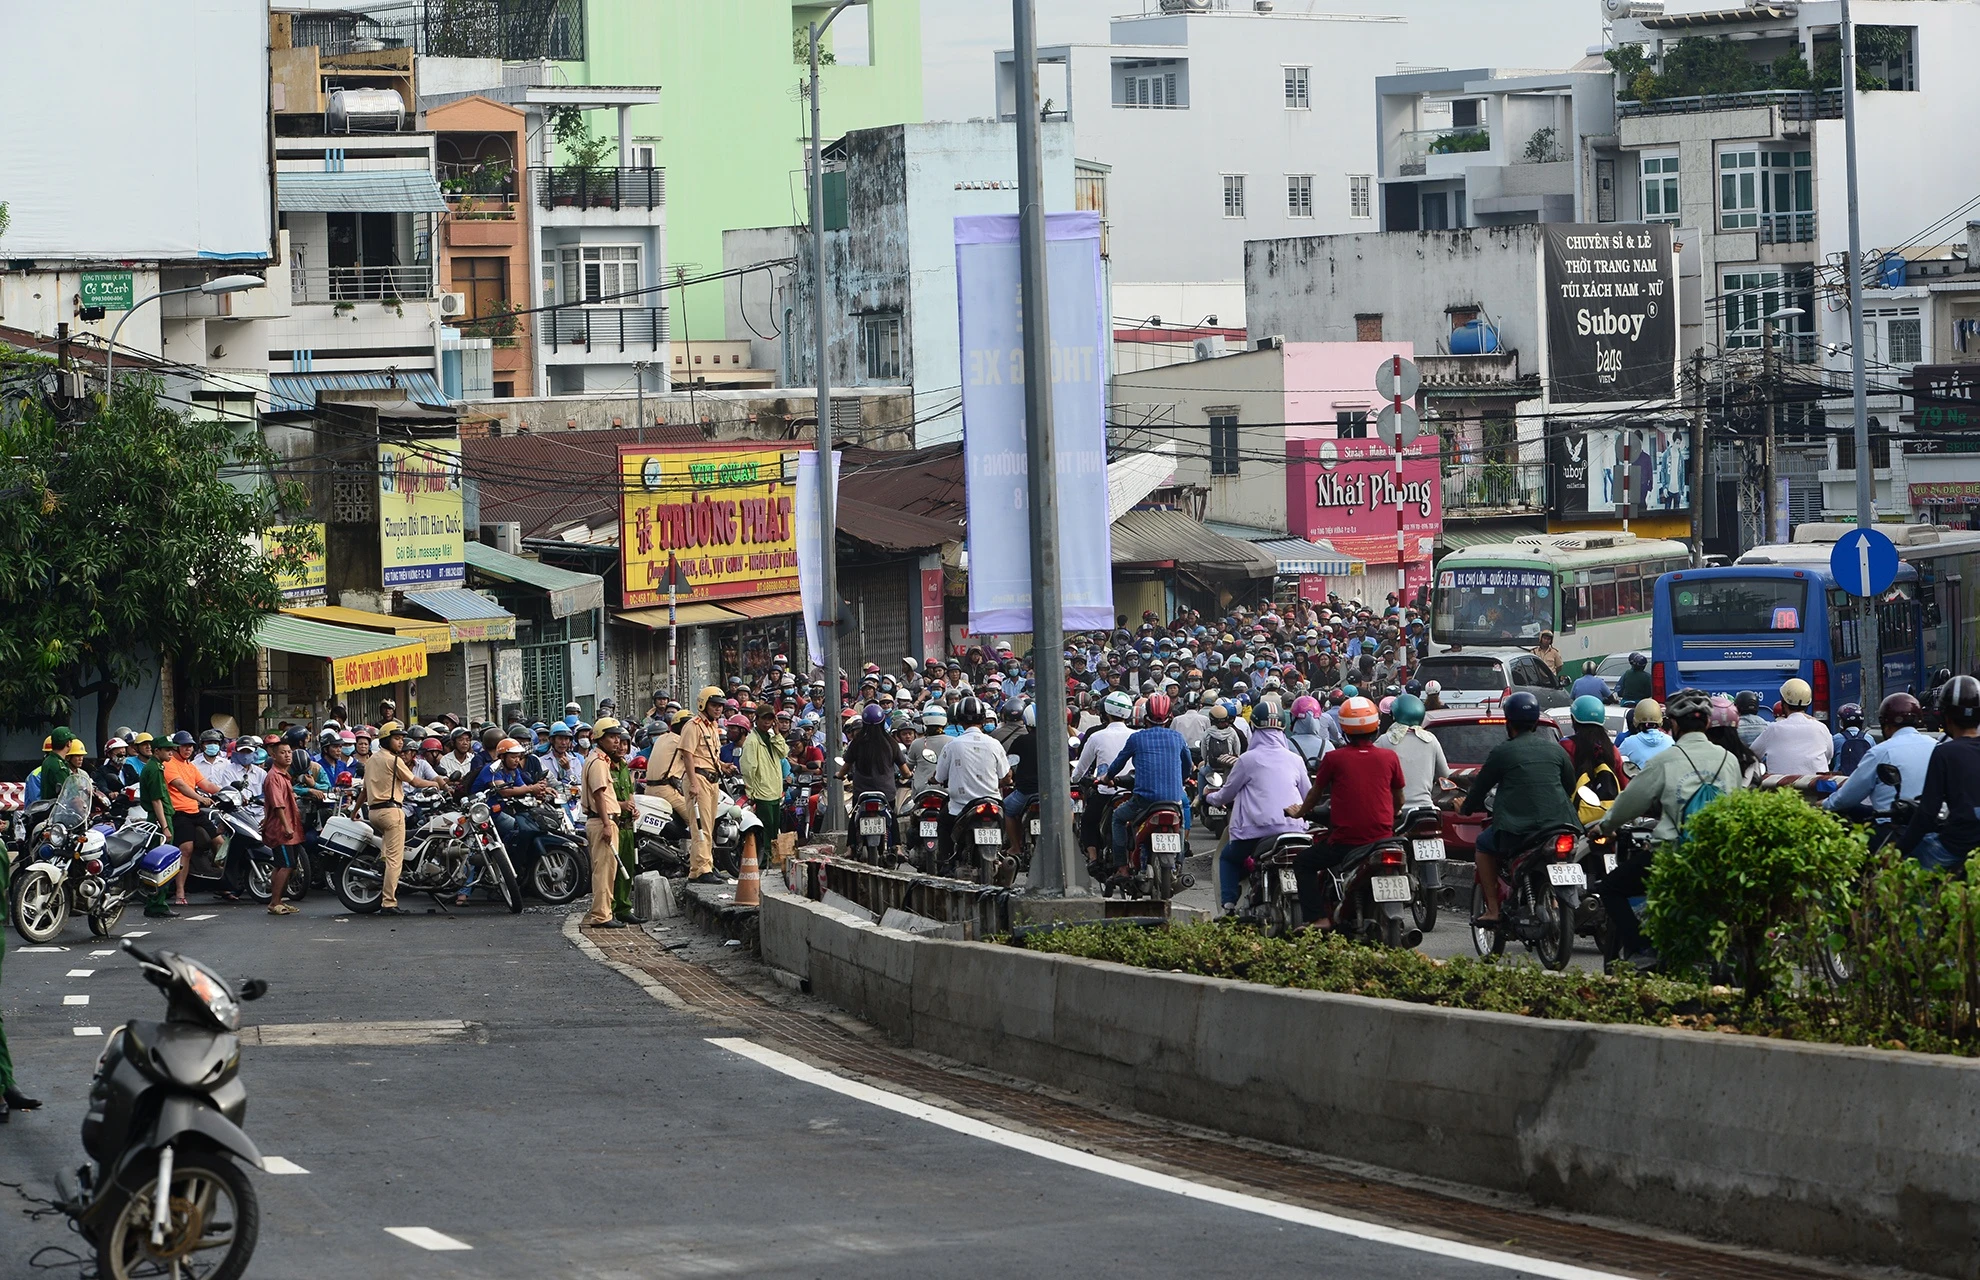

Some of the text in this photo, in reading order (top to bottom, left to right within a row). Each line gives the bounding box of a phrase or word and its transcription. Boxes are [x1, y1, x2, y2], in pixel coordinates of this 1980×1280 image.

[1566, 230, 1652, 250] CHUYÊN SỈ & LẺ
[1565, 256, 1657, 274] THỜI TRANG NAM
[1561, 281, 1580, 298] TÚI
[1582, 280, 1612, 298] XÁCH
[1615, 283, 1638, 296] NAM
[1649, 280, 1664, 296] NỮ
[1577, 307, 1645, 342] Suboy
[1596, 341, 1622, 382] bags
[1919, 406, 1942, 426] 79
[689, 462, 760, 488] VỊT QUAY
[1563, 464, 1584, 480] uboy
[1316, 472, 1365, 515] Nhật
[431, 514, 444, 534] Hàn
[445, 510, 460, 533] Quốc
[658, 491, 738, 549] TRƯỜNG
[740, 483, 792, 544] PHÁT
[726, 556, 744, 572] QUAY
[749, 550, 768, 575] NHẬN
[783, 548, 798, 567] HÀN
[1440, 572, 1454, 586] 47
[1465, 572, 1476, 588] CHỢ
[1490, 570, 1504, 586] QUỐC
[1504, 572, 1511, 587] LỘ
[1536, 574, 1550, 586] LONG
[345, 662, 357, 685] 466
[358, 659, 370, 683] TÙNG
[371, 656, 384, 680] THIÊN
[384, 654, 399, 679] VƯƠNG
[644, 816, 664, 827] CSGT
[1419, 850, 1440, 859] 2473
